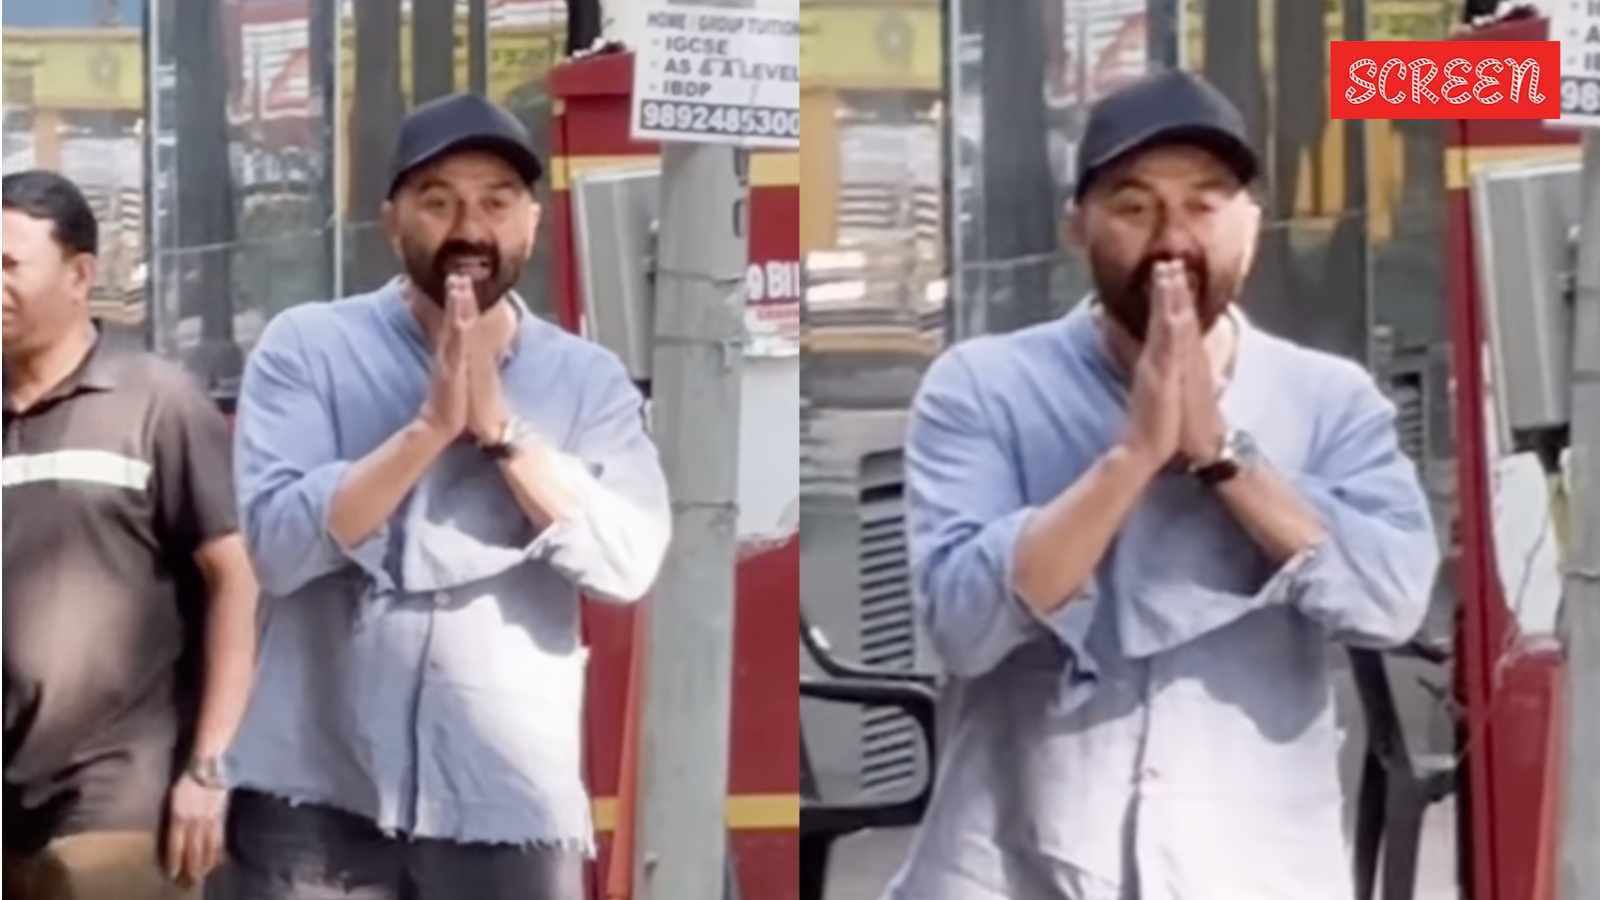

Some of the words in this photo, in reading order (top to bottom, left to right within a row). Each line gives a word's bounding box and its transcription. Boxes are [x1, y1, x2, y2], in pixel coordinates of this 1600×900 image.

[699, 15, 744, 33] GROUP
[665, 36, 728, 55] IGCSE
[664, 58, 690, 74] AS
[720, 60, 733, 77] A
[663, 80, 712, 97] IBDP
